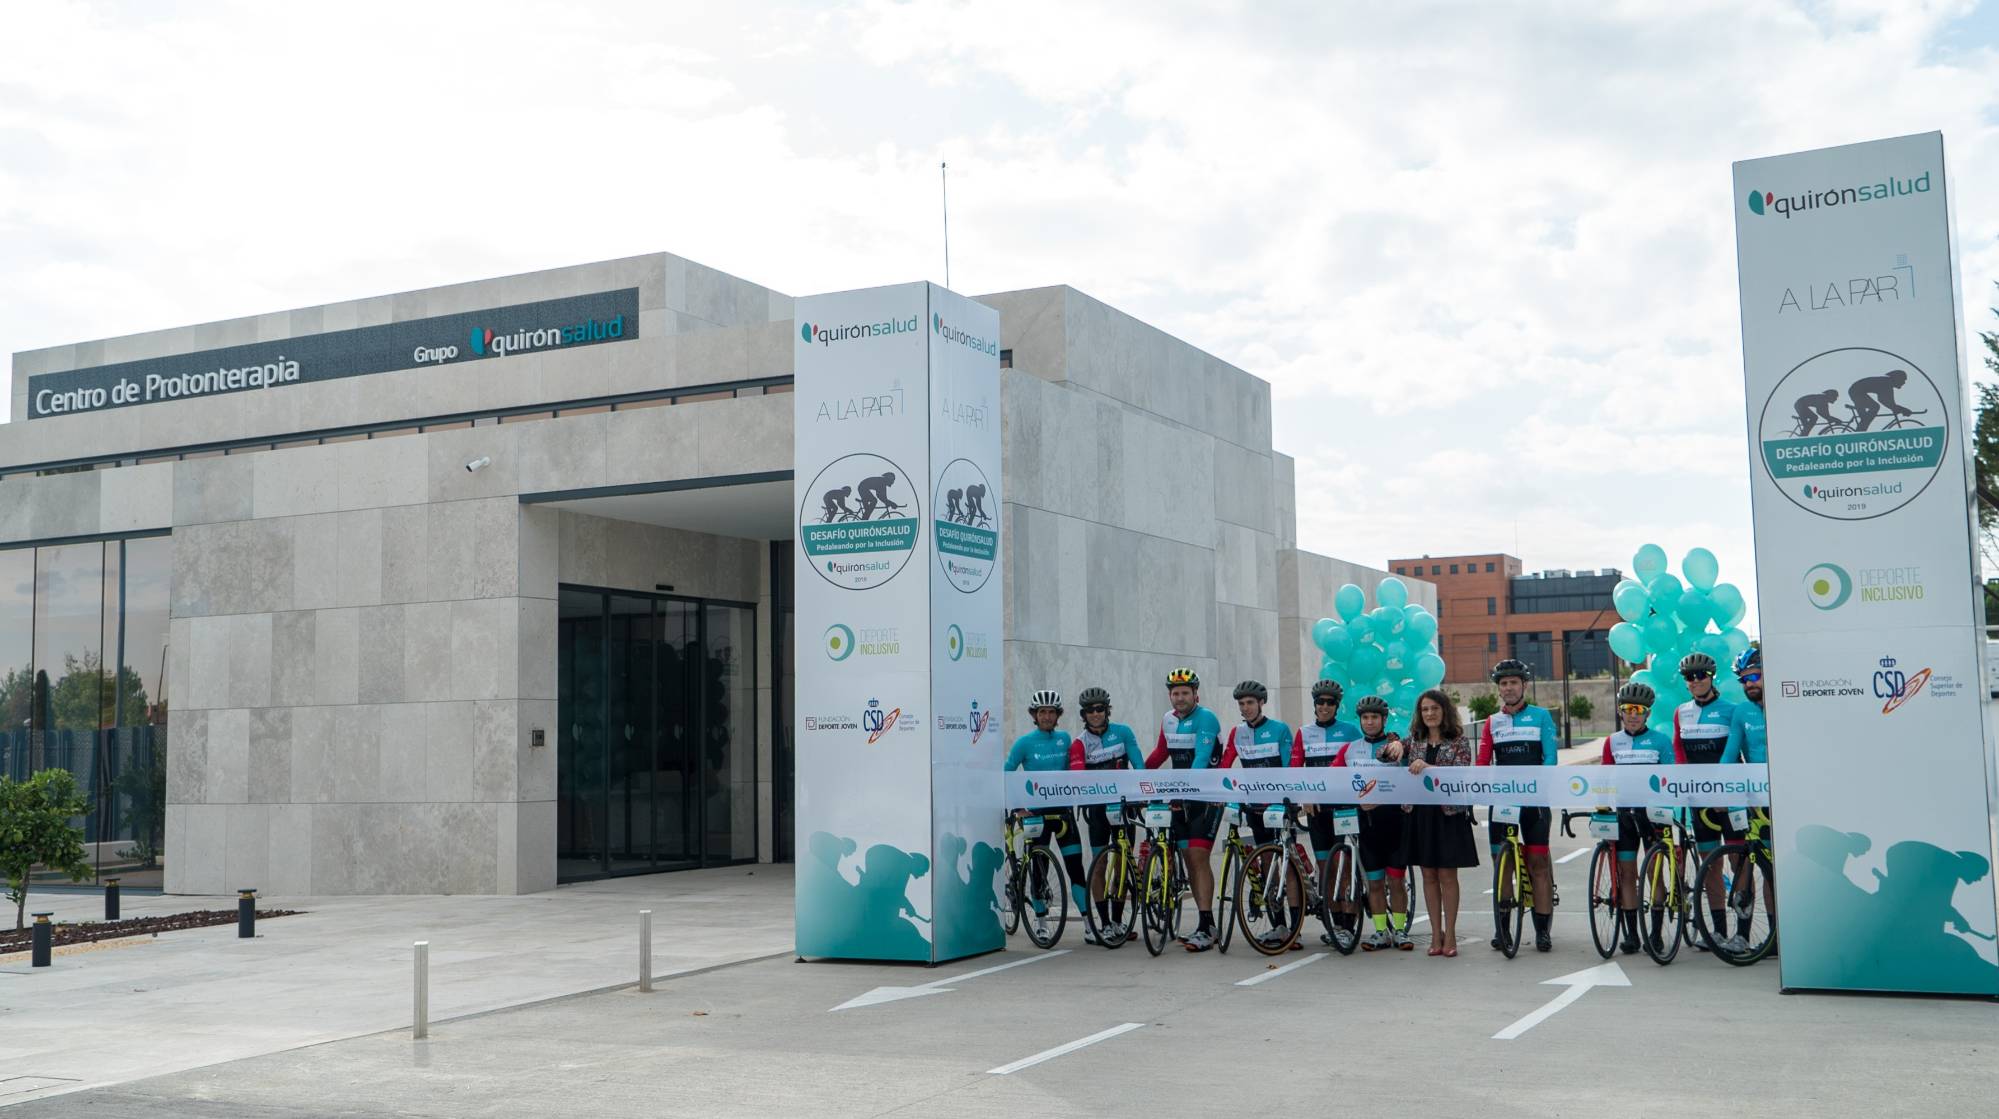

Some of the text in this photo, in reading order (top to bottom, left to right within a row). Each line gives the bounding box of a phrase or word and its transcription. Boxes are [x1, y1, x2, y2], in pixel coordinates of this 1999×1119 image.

[1774, 171, 1931, 219] quirónsalud
[1778, 288, 1801, 314] A
[1810, 282, 1845, 311] LA
[413, 313, 624, 364] Grupo quirónsalud
[818, 315, 918, 347] quirónsalud
[942, 325, 996, 356] quirónsalud
[36, 356, 301, 416] Centro de Protonterapia
[816, 400, 831, 422] A
[837, 399, 858, 420] LA
[1776, 436, 1933, 460] DESAFÍO QUIRÓNSALUD
[1786, 453, 1924, 472] Pedaleando por la Inclusión
[1817, 482, 1902, 502] quirónsalud
[810, 525, 910, 541] DESAFÍO QUIRÓNSALUD
[816, 541, 854, 551] Pedaleando
[855, 542, 866, 551] por
[867, 540, 874, 548] la
[836, 560, 890, 575] quirónsalud
[1859, 567, 1921, 586] DEPORTE
[1861, 584, 1924, 602] INCLUSIVO
[860, 643, 900, 656] INCLUSIVO
[1801, 678, 1852, 687] FUNDACIÓN
[1873, 671, 1905, 699] CSD
[1802, 688, 1864, 697] DEPORTE JOVEN
[841, 722, 858, 730] JOVEN
[863, 710, 884, 732] CSD
[1038, 783, 1118, 801] quirónsalud
[1238, 780, 1327, 795] quirónsalud
[1440, 779, 1537, 796] quirónsalud
